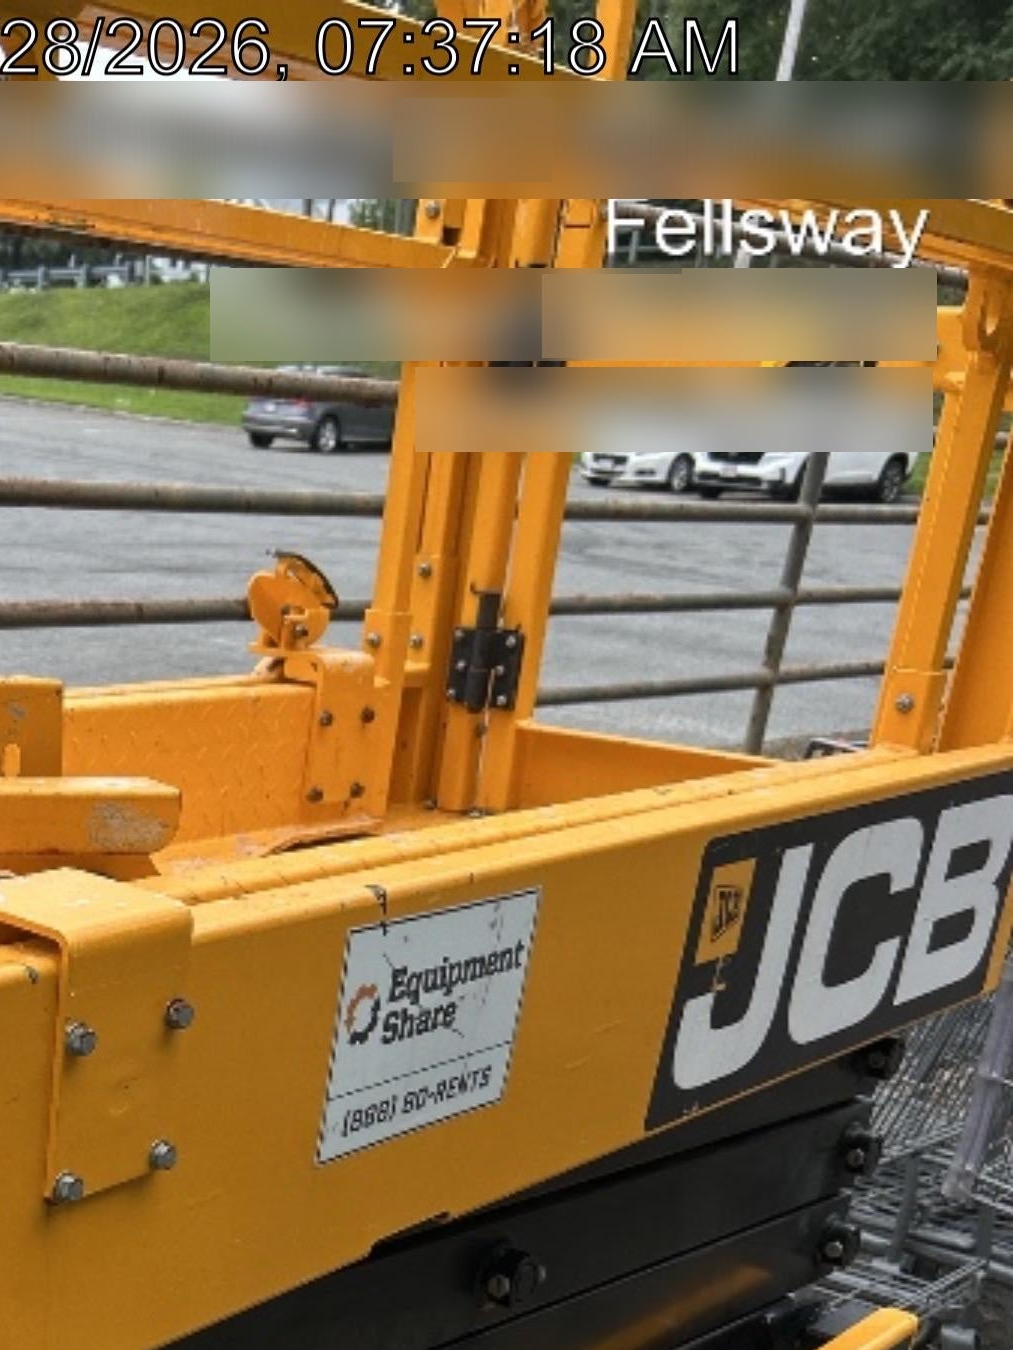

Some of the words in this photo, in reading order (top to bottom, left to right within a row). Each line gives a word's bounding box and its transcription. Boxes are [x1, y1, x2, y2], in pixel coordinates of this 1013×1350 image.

[388, 939, 525, 1005] Equipment
[672, 793, 1013, 1090] JCB
[381, 1000, 458, 1045] Share
